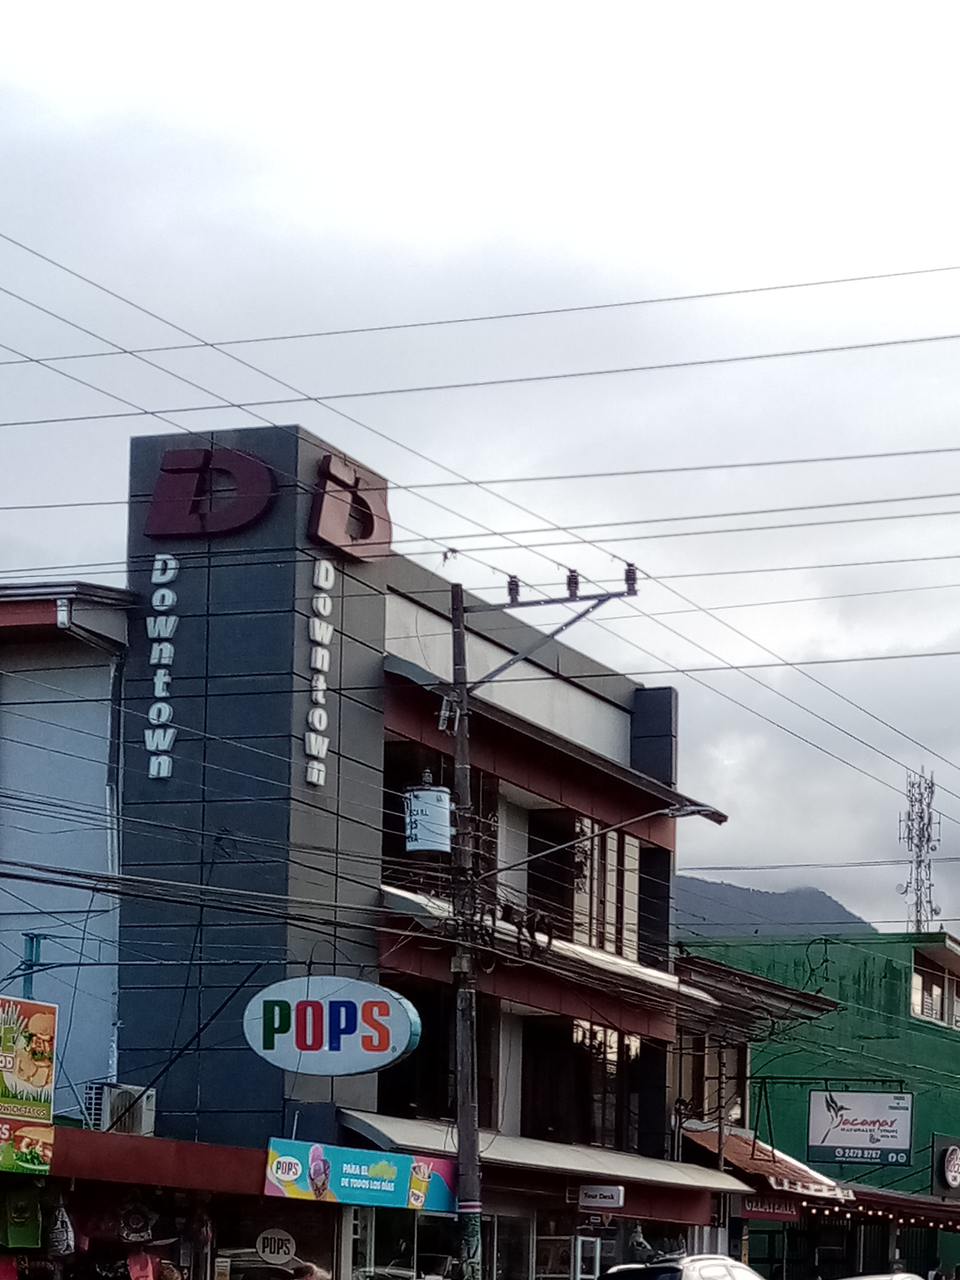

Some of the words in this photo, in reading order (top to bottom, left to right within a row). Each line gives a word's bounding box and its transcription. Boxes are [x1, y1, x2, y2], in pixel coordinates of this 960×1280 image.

[262, 1000, 390, 1053] POPS
[832, 1113, 897, 1130] Jacamar
[276, 1160, 299, 1176] POPS
[745, 1198, 797, 1215] GELATERIA
[262, 1236, 291, 1256] POPS
